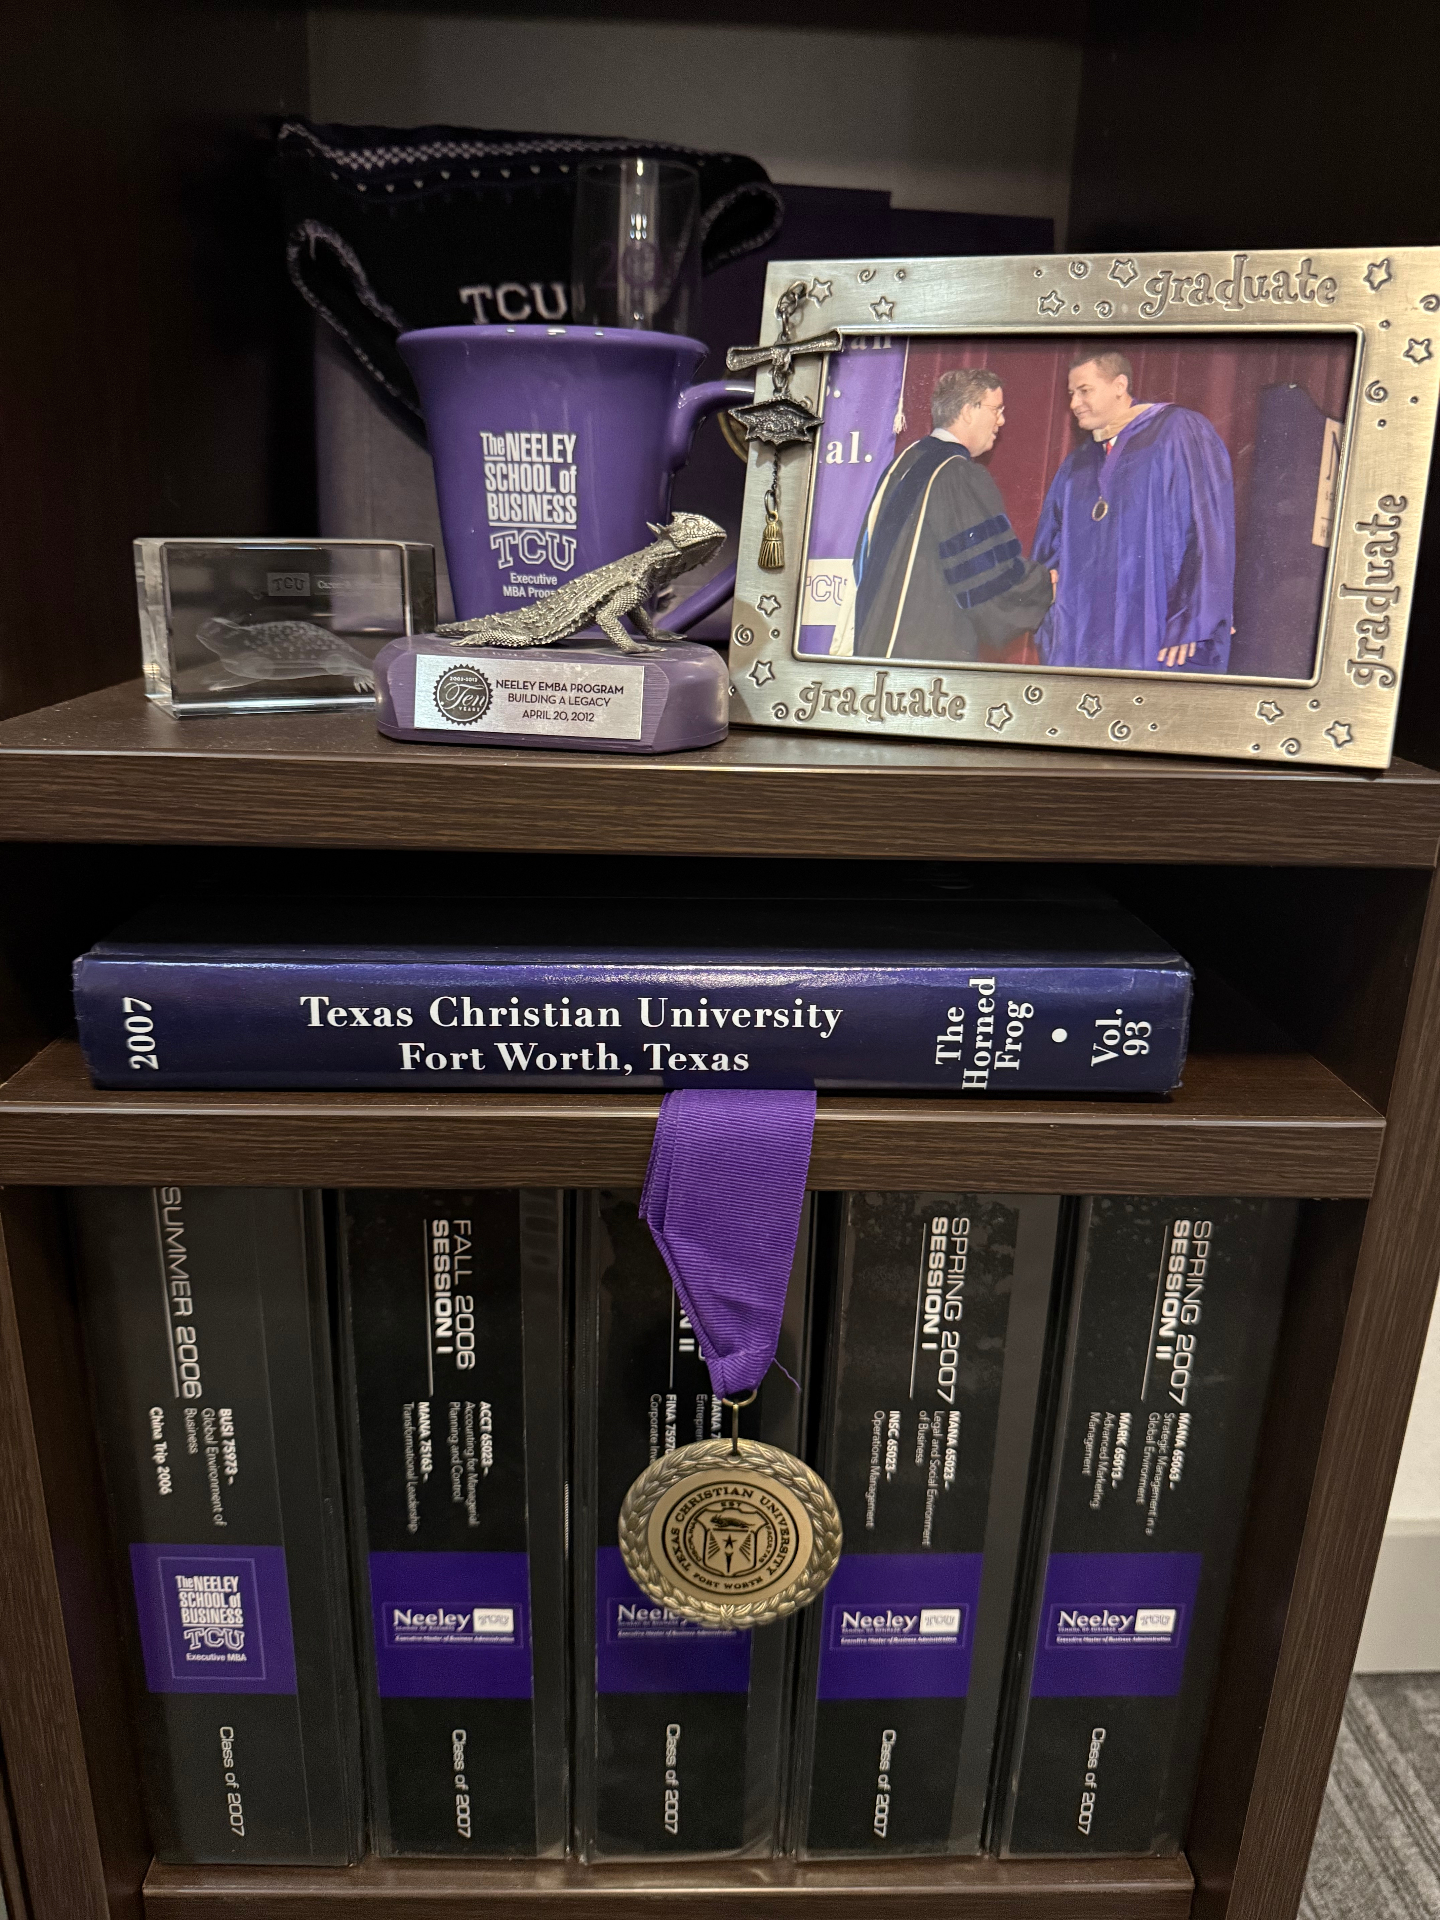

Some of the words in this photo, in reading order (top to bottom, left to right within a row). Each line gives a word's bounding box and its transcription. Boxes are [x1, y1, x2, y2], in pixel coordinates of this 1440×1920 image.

[458, 282, 568, 326] TCU
[1139, 254, 1338, 318] graduate
[480, 431, 505, 456] The
[505, 431, 577, 463] NEELEY
[819, 431, 872, 464] al.
[484, 463, 556, 493] SCHOOL
[559, 465, 577, 493] of
[486, 492, 577, 523] BUSINESS
[490, 530, 577, 572] TCU
[503, 586, 526, 598] MBA
[510, 573, 558, 585] Executive
[806, 575, 847, 606] CU
[1340, 493, 1407, 689] graduate
[443, 682, 486, 710] Ten
[496, 679, 536, 691] NEELEY
[538, 681, 567, 692] EMBA
[570, 683, 624, 695] PROGRAM
[508, 693, 557, 704] BUILDING
[559, 696, 566, 705] A
[568, 696, 611, 707] LEGACY
[794, 671, 966, 722] graduate
[522, 710, 551, 720] APRIL
[553, 711, 569, 721] 20,
[571, 711, 595, 722] 2012
[122, 996, 159, 1070] 2007
[301, 995, 414, 1028] Texas
[429, 996, 622, 1028] Christian
[638, 996, 844, 1039] University
[935, 1005, 965, 1064] The
[962, 976, 997, 1090] Horned
[994, 1000, 1034, 1070] Frog
[1091, 1008, 1123, 1068] Vol.
[1123, 1020, 1153, 1056] 93
[400, 1042, 486, 1071] Fort
[494, 1042, 633, 1076] Worth,
[643, 1042, 750, 1072] Texas
[161, 1187, 193, 1317] SUMMER
[453, 1219, 472, 1286] FALL
[944, 1217, 969, 1321] SPRING
[432, 1219, 452, 1338] SESSION
[924, 1216, 948, 1334] SESSION
[1159, 1219, 1191, 1338] SESSION
[1181, 1220, 1212, 1325] SPRING
[436, 1346, 453, 1354] I
[455, 1295, 476, 1370] 2006
[921, 1342, 938, 1350] I
[176, 1326, 202, 1399] 2006
[937, 1331, 960, 1405] 2007
[1155, 1345, 1174, 1360] II
[1169, 1334, 1196, 1406] 2007
[149, 1406, 164, 1440] China
[202, 1407, 218, 1444] Global
[219, 1408, 234, 1436] BUSI
[418, 1401, 430, 1438] MANA
[447, 1401, 461, 1444] Planning
[479, 1401, 492, 1432] ACCT
[648, 1393, 662, 1444] Corporate
[665, 1394, 677, 1422] FINA
[887, 1410, 900, 1437] INSC
[919, 1410, 930, 1422] of
[930, 1410, 944, 1437] Legal
[184, 1407, 198, 1454] Business
[403, 1402, 417, 1480] Transformational
[463, 1401, 476, 1457] Accounting
[870, 1410, 885, 1464] Operations
[915, 1423, 928, 1464] Business
[946, 1410, 960, 1446] MANA
[1082, 1411, 1101, 1475] Management
[1098, 1411, 1115, 1460] Advanced
[1116, 1412, 1131, 1445] MARK
[1145, 1412, 1160, 1444] Global
[1157, 1412, 1175, 1453] Strategic
[1174, 1412, 1190, 1448] MANA
[152, 1441, 168, 1464] Trip
[450, 1444, 462, 1464] and
[466, 1457, 478, 1471] for
[930, 1438, 941, 1458] and
[157, 1466, 172, 1495] 2006
[205, 1446, 223, 1512] Environment
[451, 1465, 464, 1501] Control
[927, 1459, 941, 1487] Social
[1089, 1461, 1108, 1508] Marketing
[1136, 1446, 1154, 1504] Environment
[1148, 1455, 1168, 1515] Management
[406, 1481, 420, 1532] Leadership
[465, 1472, 480, 1525] Managerial
[675, 1487, 754, 1523] CHRISTIAN
[865, 1465, 880, 1527] Management
[213, 1513, 227, 1526] of
[922, 1488, 937, 1546] Environment
[1145, 1527, 1153, 1535] a
[1146, 1517, 1155, 1526] in
[671, 1527, 691, 1572] TEXAS
[760, 1496, 790, 1576] UNIVERSITY
[175, 1575, 194, 1588] The
[193, 1575, 239, 1592] NEELEY
[179, 1591, 228, 1608] SCHOOL
[229, 1592, 241, 1608] of
[693, 1572, 720, 1588] FORT
[723, 1576, 764, 1590] WORTH
[181, 1608, 243, 1624] BUSINESS
[393, 1608, 471, 1632] Neeley
[618, 1604, 687, 1627] Neel
[841, 1610, 918, 1633] Neeley
[1057, 1609, 1134, 1632] Neeley
[183, 1627, 245, 1651] TCU
[186, 1652, 226, 1661] Executive
[227, 1653, 247, 1661] MBA
[220, 1726, 234, 1768] Class
[452, 1729, 466, 1771] Class
[665, 1724, 680, 1768] Class
[879, 1729, 897, 1771] Class
[1087, 1727, 1106, 1769] Class
[225, 1772, 239, 1789] of
[455, 1774, 469, 1791] of
[665, 1769, 679, 1787] of
[878, 1774, 891, 1791] of
[1085, 1772, 1097, 1789] of
[228, 1793, 245, 1837] 2007
[456, 1794, 471, 1838] 2007
[665, 1789, 679, 1835] 2007
[874, 1793, 890, 1838] 2007
[1078, 1792, 1095, 1836] 2007
